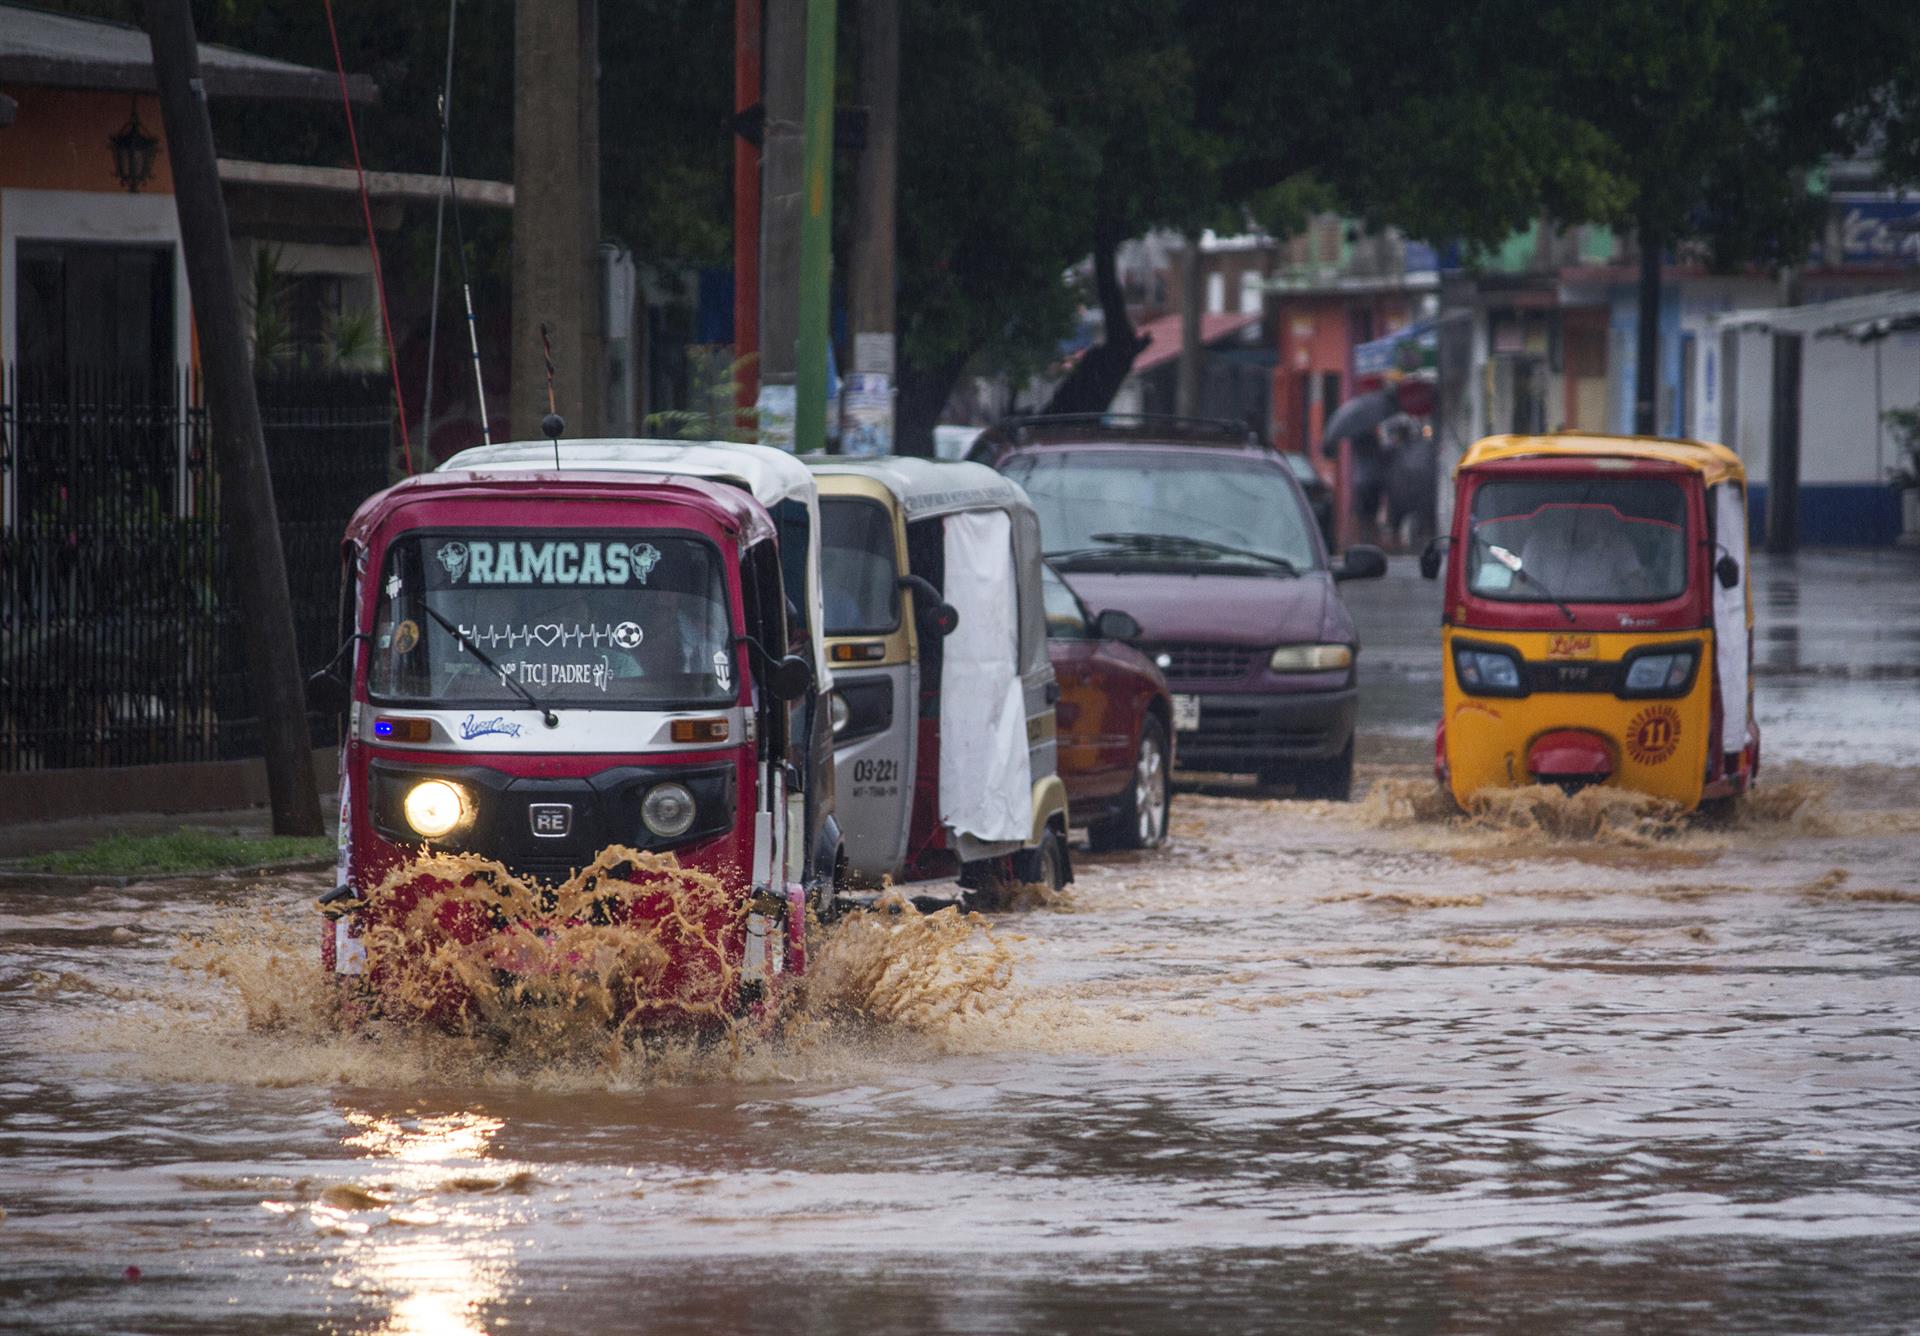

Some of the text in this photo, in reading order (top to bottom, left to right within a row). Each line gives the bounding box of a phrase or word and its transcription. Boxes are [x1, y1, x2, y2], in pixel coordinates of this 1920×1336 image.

[468, 541, 630, 585] RAMCAS
[551, 663, 592, 684] PADRE
[1645, 721, 1666, 748] 11
[536, 814, 565, 830] RE
